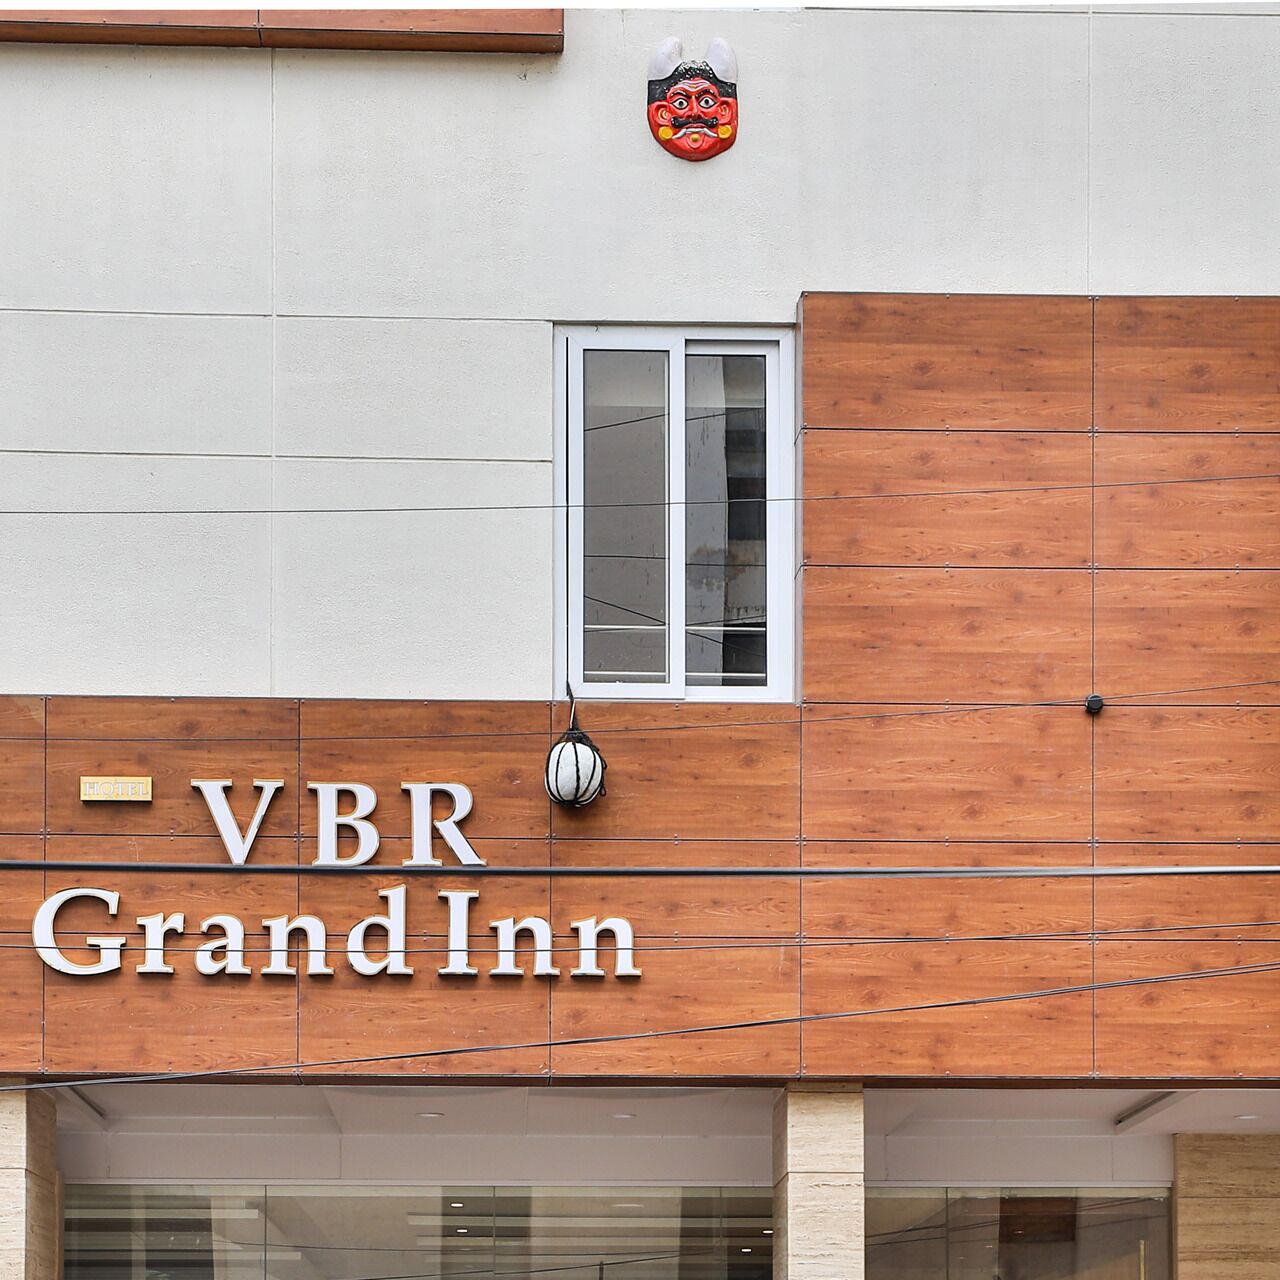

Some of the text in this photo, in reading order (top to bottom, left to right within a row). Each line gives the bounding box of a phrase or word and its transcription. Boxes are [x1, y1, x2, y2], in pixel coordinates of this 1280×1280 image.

[84, 782, 149, 796] HOTEL
[190, 778, 487, 868] VBR
[32, 884, 643, 977] Grand Inn
